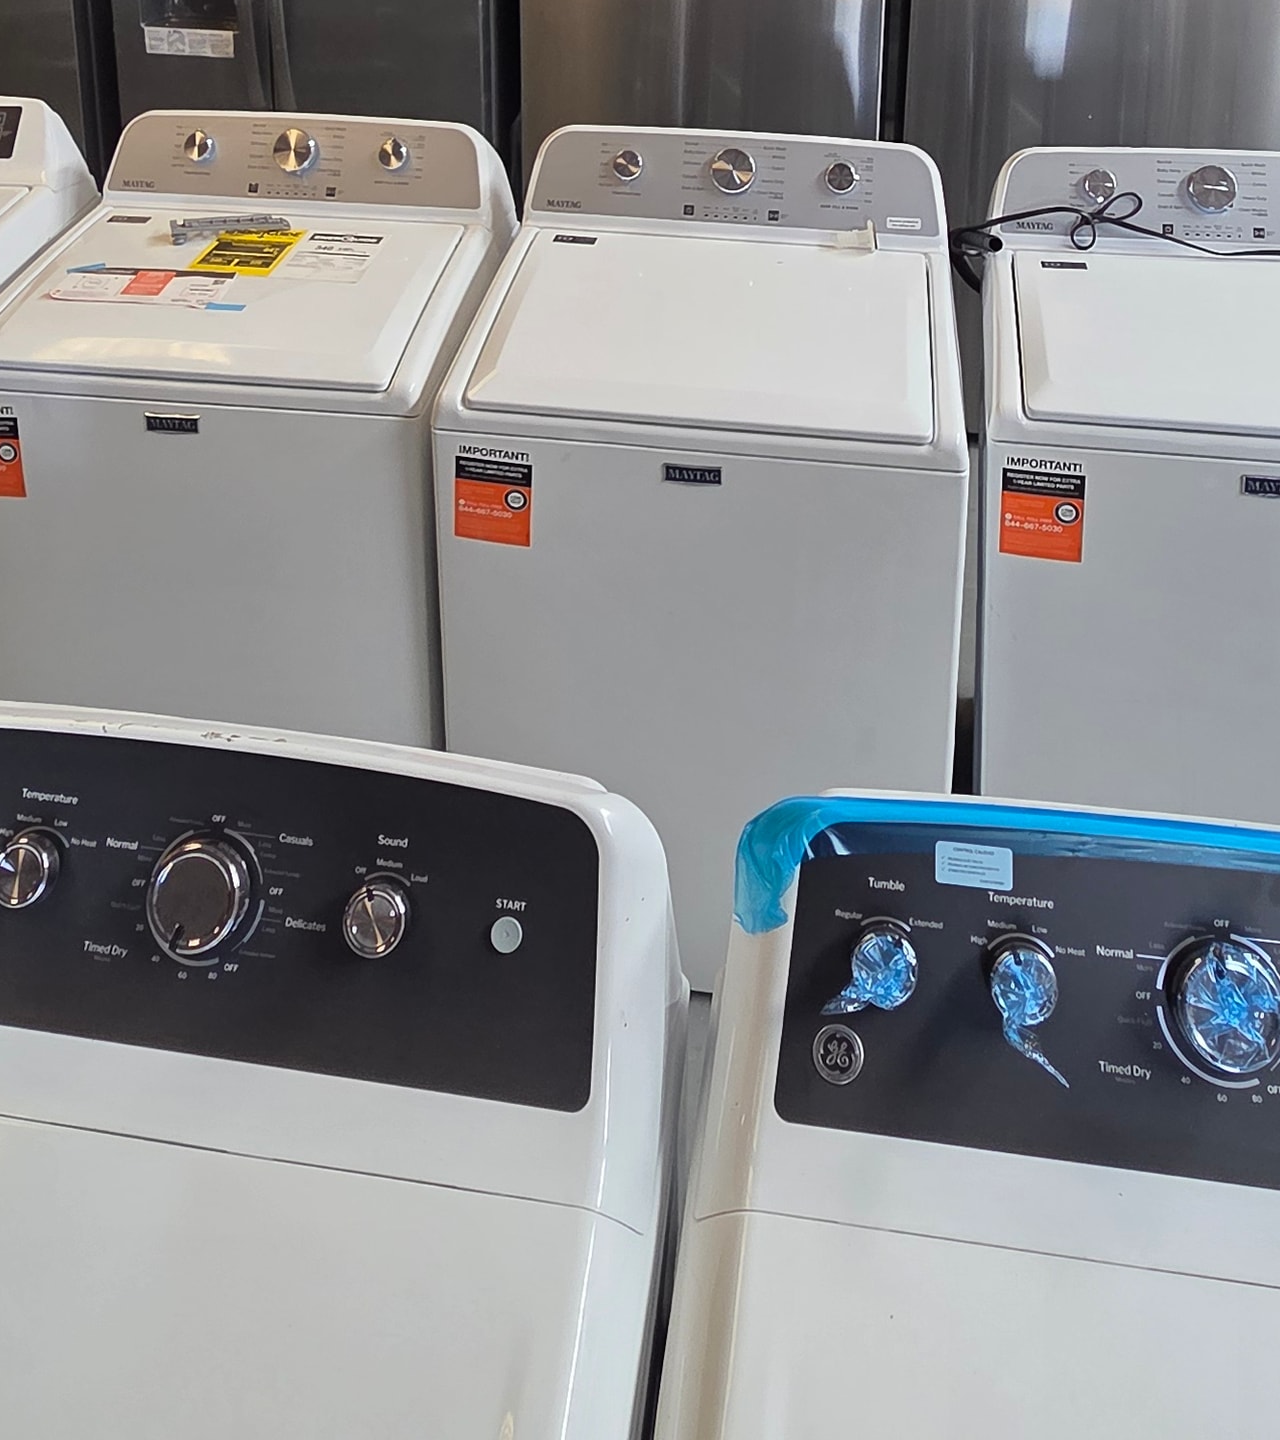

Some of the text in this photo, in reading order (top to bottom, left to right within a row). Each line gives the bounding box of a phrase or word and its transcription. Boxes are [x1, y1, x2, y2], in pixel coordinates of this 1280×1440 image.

[1015, 221, 1054, 231] MAYTAG
[459, 445, 529, 462] IMPORTANT!
[1006, 456, 1082, 472] IMPORTANT!
[668, 469, 720, 481] MAYTAG
[21, 788, 78, 805] Temperature
[53, 818, 68, 828] Low
[211, 814, 226, 823] OFF
[106, 837, 138, 851] Normal
[278, 833, 313, 847] Casuals
[378, 835, 408, 848] Sound
[376, 858, 403, 868] Medium
[355, 866, 367, 874] Off
[131, 878, 146, 887] OFF
[411, 874, 428, 883] Loud
[868, 877, 905, 892] Tumble
[269, 887, 284, 896] OFF
[496, 898, 526, 911] START
[988, 891, 1054, 909] Temperature
[834, 908, 863, 920] Regular
[285, 917, 326, 932] Delicates
[909, 917, 944, 929] Extended
[987, 919, 1017, 931] Medium
[1032, 924, 1048, 934] Low
[1214, 919, 1230, 928] OFF
[970, 934, 988, 946] High
[83, 940, 128, 958] Timed Dry
[1055, 945, 1086, 957] No Heat
[1096, 945, 1134, 960] Normal
[223, 963, 239, 973] OFF
[1135, 991, 1151, 1000] OFF
[1153, 1041, 1162, 1050] 20
[1098, 1060, 1152, 1080] Timed Dry
[1180, 1075, 1191, 1085] 40
[1217, 1094, 1227, 1103] 60
[1252, 1095, 1263, 1104] 80
